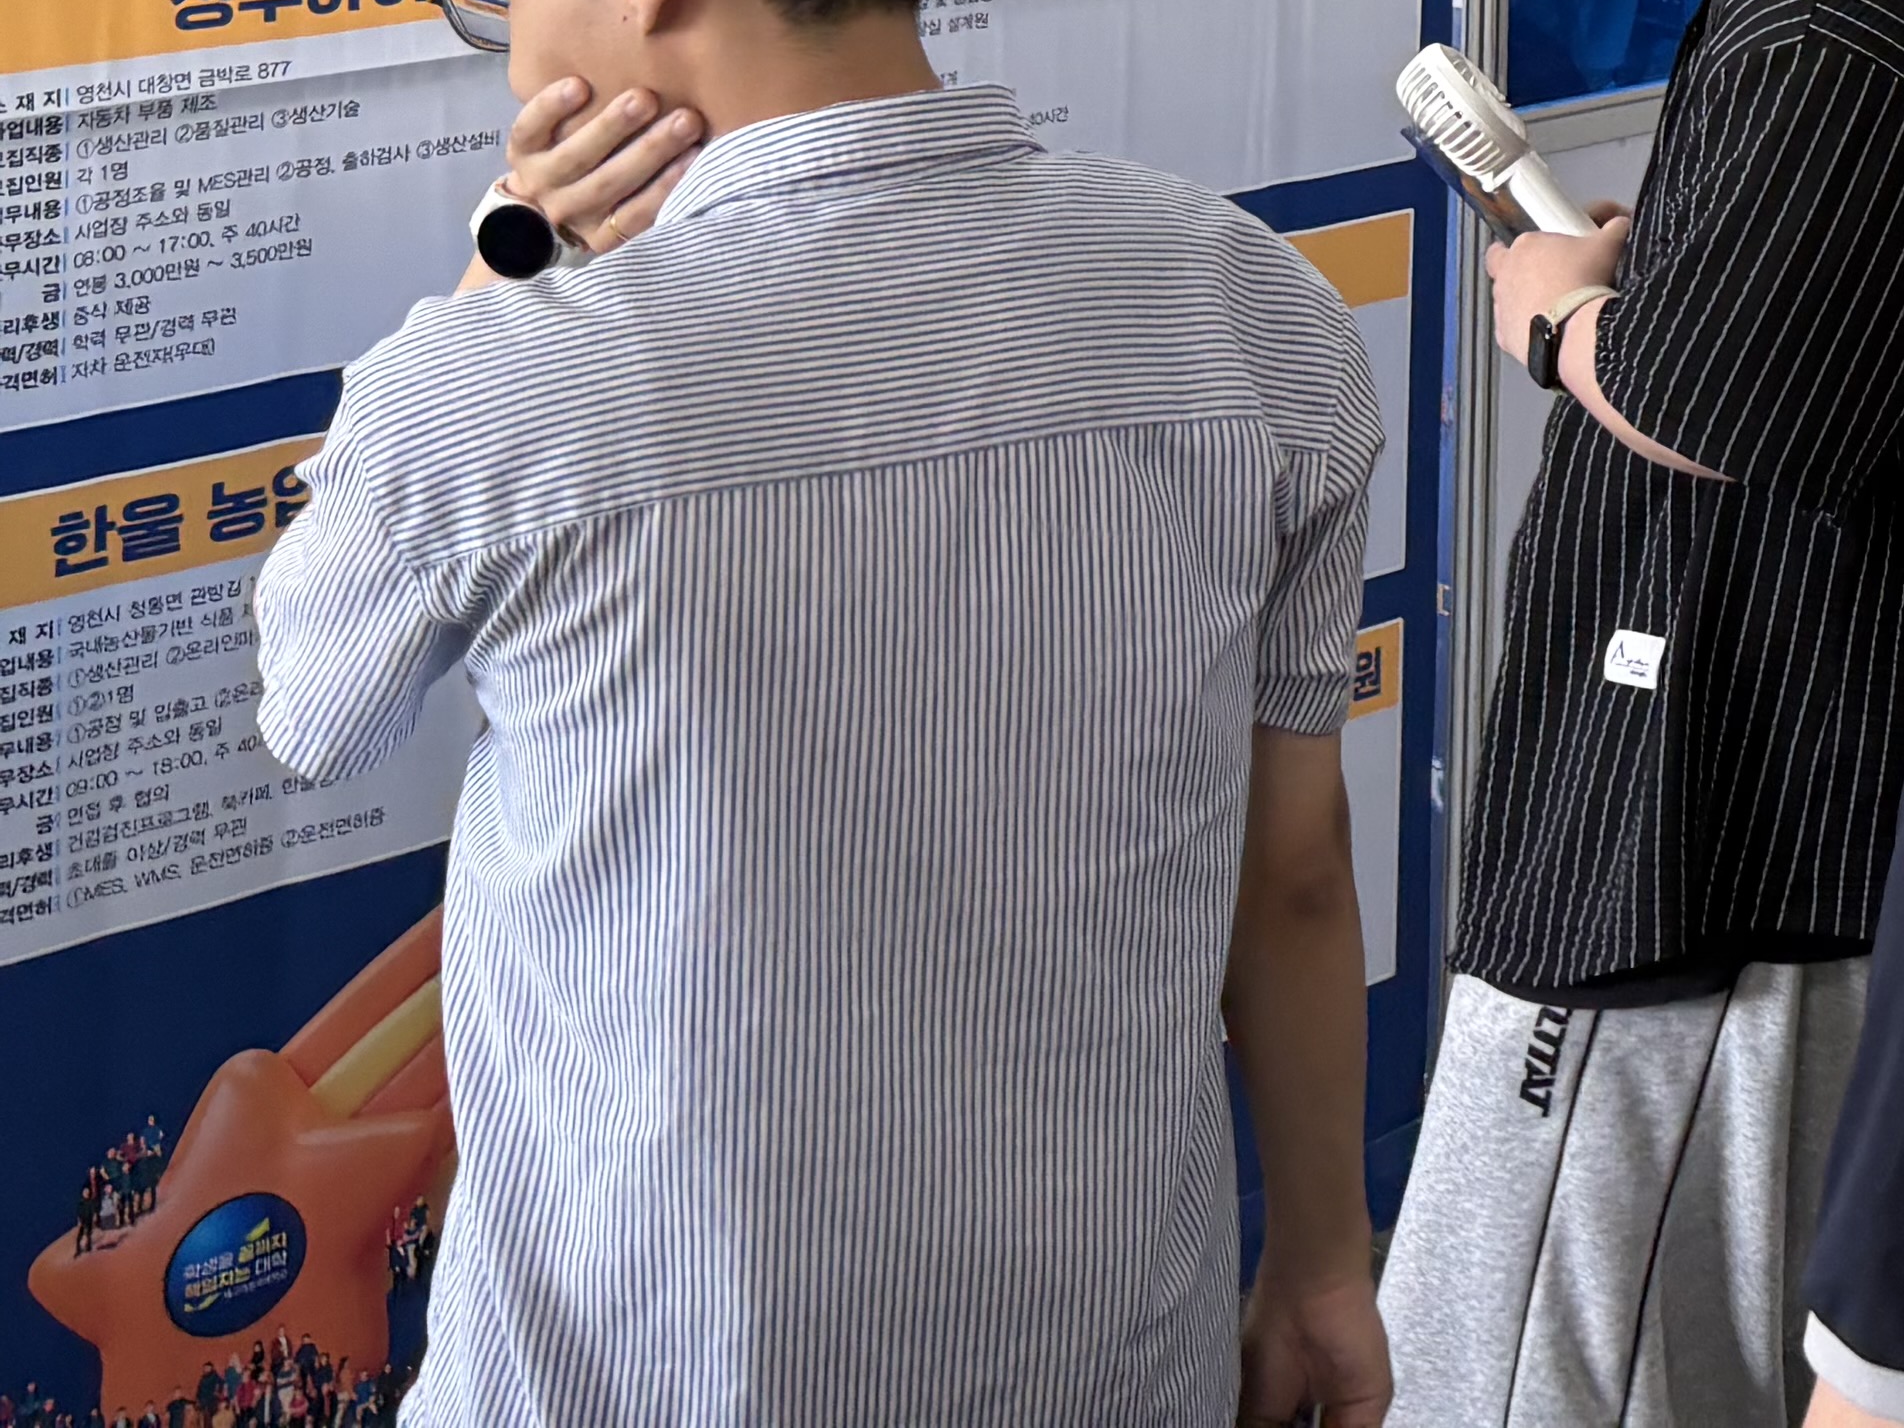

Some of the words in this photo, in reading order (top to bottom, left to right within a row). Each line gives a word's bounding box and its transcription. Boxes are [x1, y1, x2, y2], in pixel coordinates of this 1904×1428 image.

[76, 80, 130, 104] 영천시
[138, 71, 191, 94] 대창면
[198, 65, 252, 87] 금박로
[258, 61, 292, 79] 877
[77, 167, 93, 186] 각
[101, 161, 128, 182] 1명
[49, 492, 185, 578] 한울
